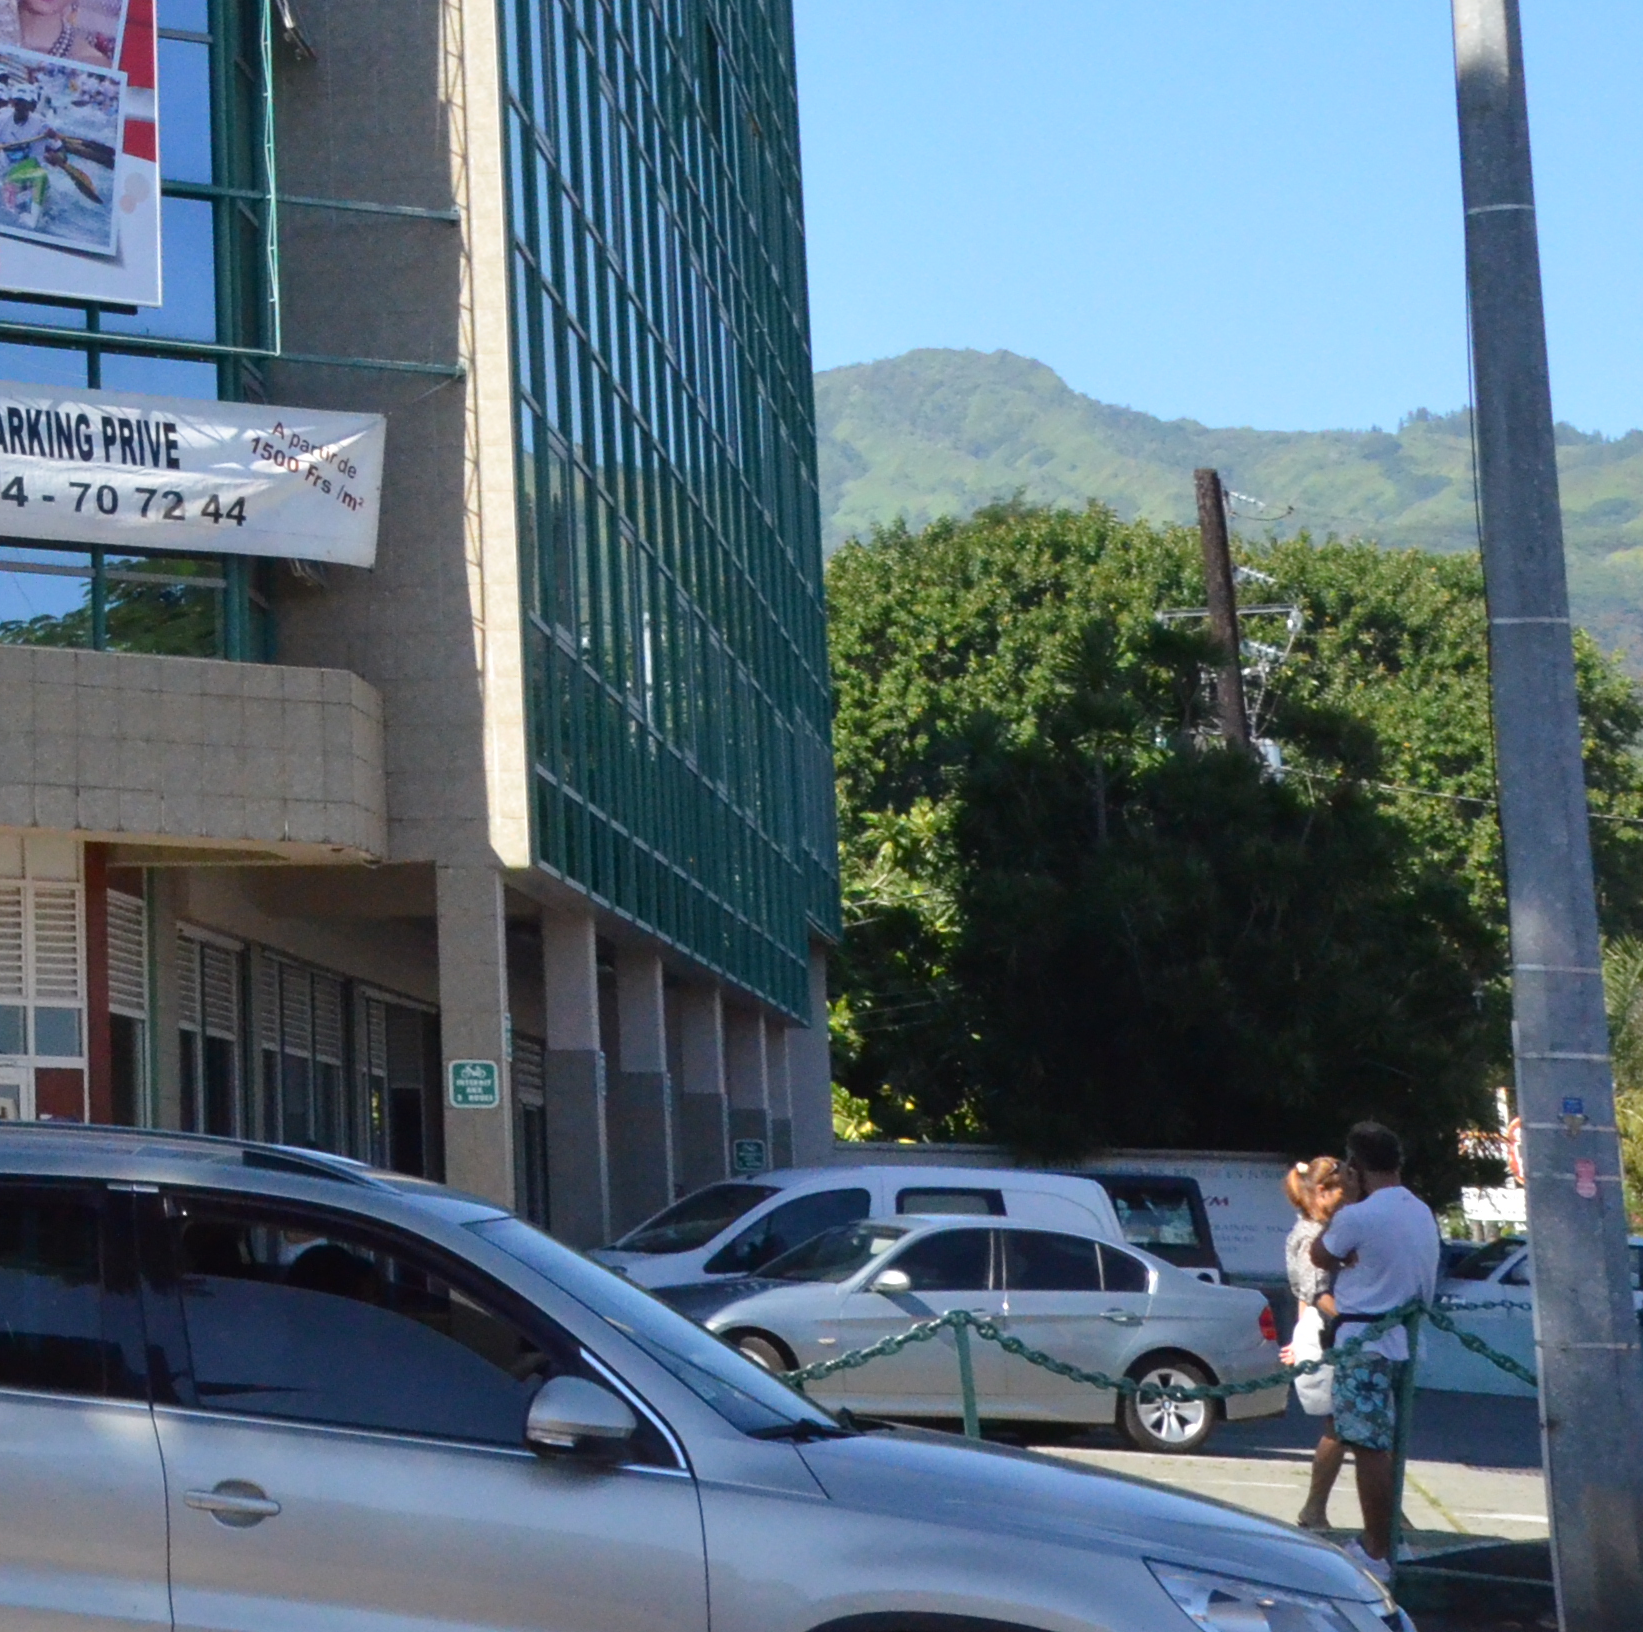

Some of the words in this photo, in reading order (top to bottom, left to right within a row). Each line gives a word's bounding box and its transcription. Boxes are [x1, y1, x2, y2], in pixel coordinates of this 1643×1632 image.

[102, 416, 181, 469] PRIVE
[251, 437, 299, 473] 1500
[305, 464, 332, 494] Frs
[272, 422, 285, 439] A
[289, 433, 337, 463] partir
[338, 458, 357, 478] de
[42, 494, 55, 502] -
[69, 482, 118, 515] 70
[135, 487, 186, 520] 72
[201, 494, 247, 526] 44
